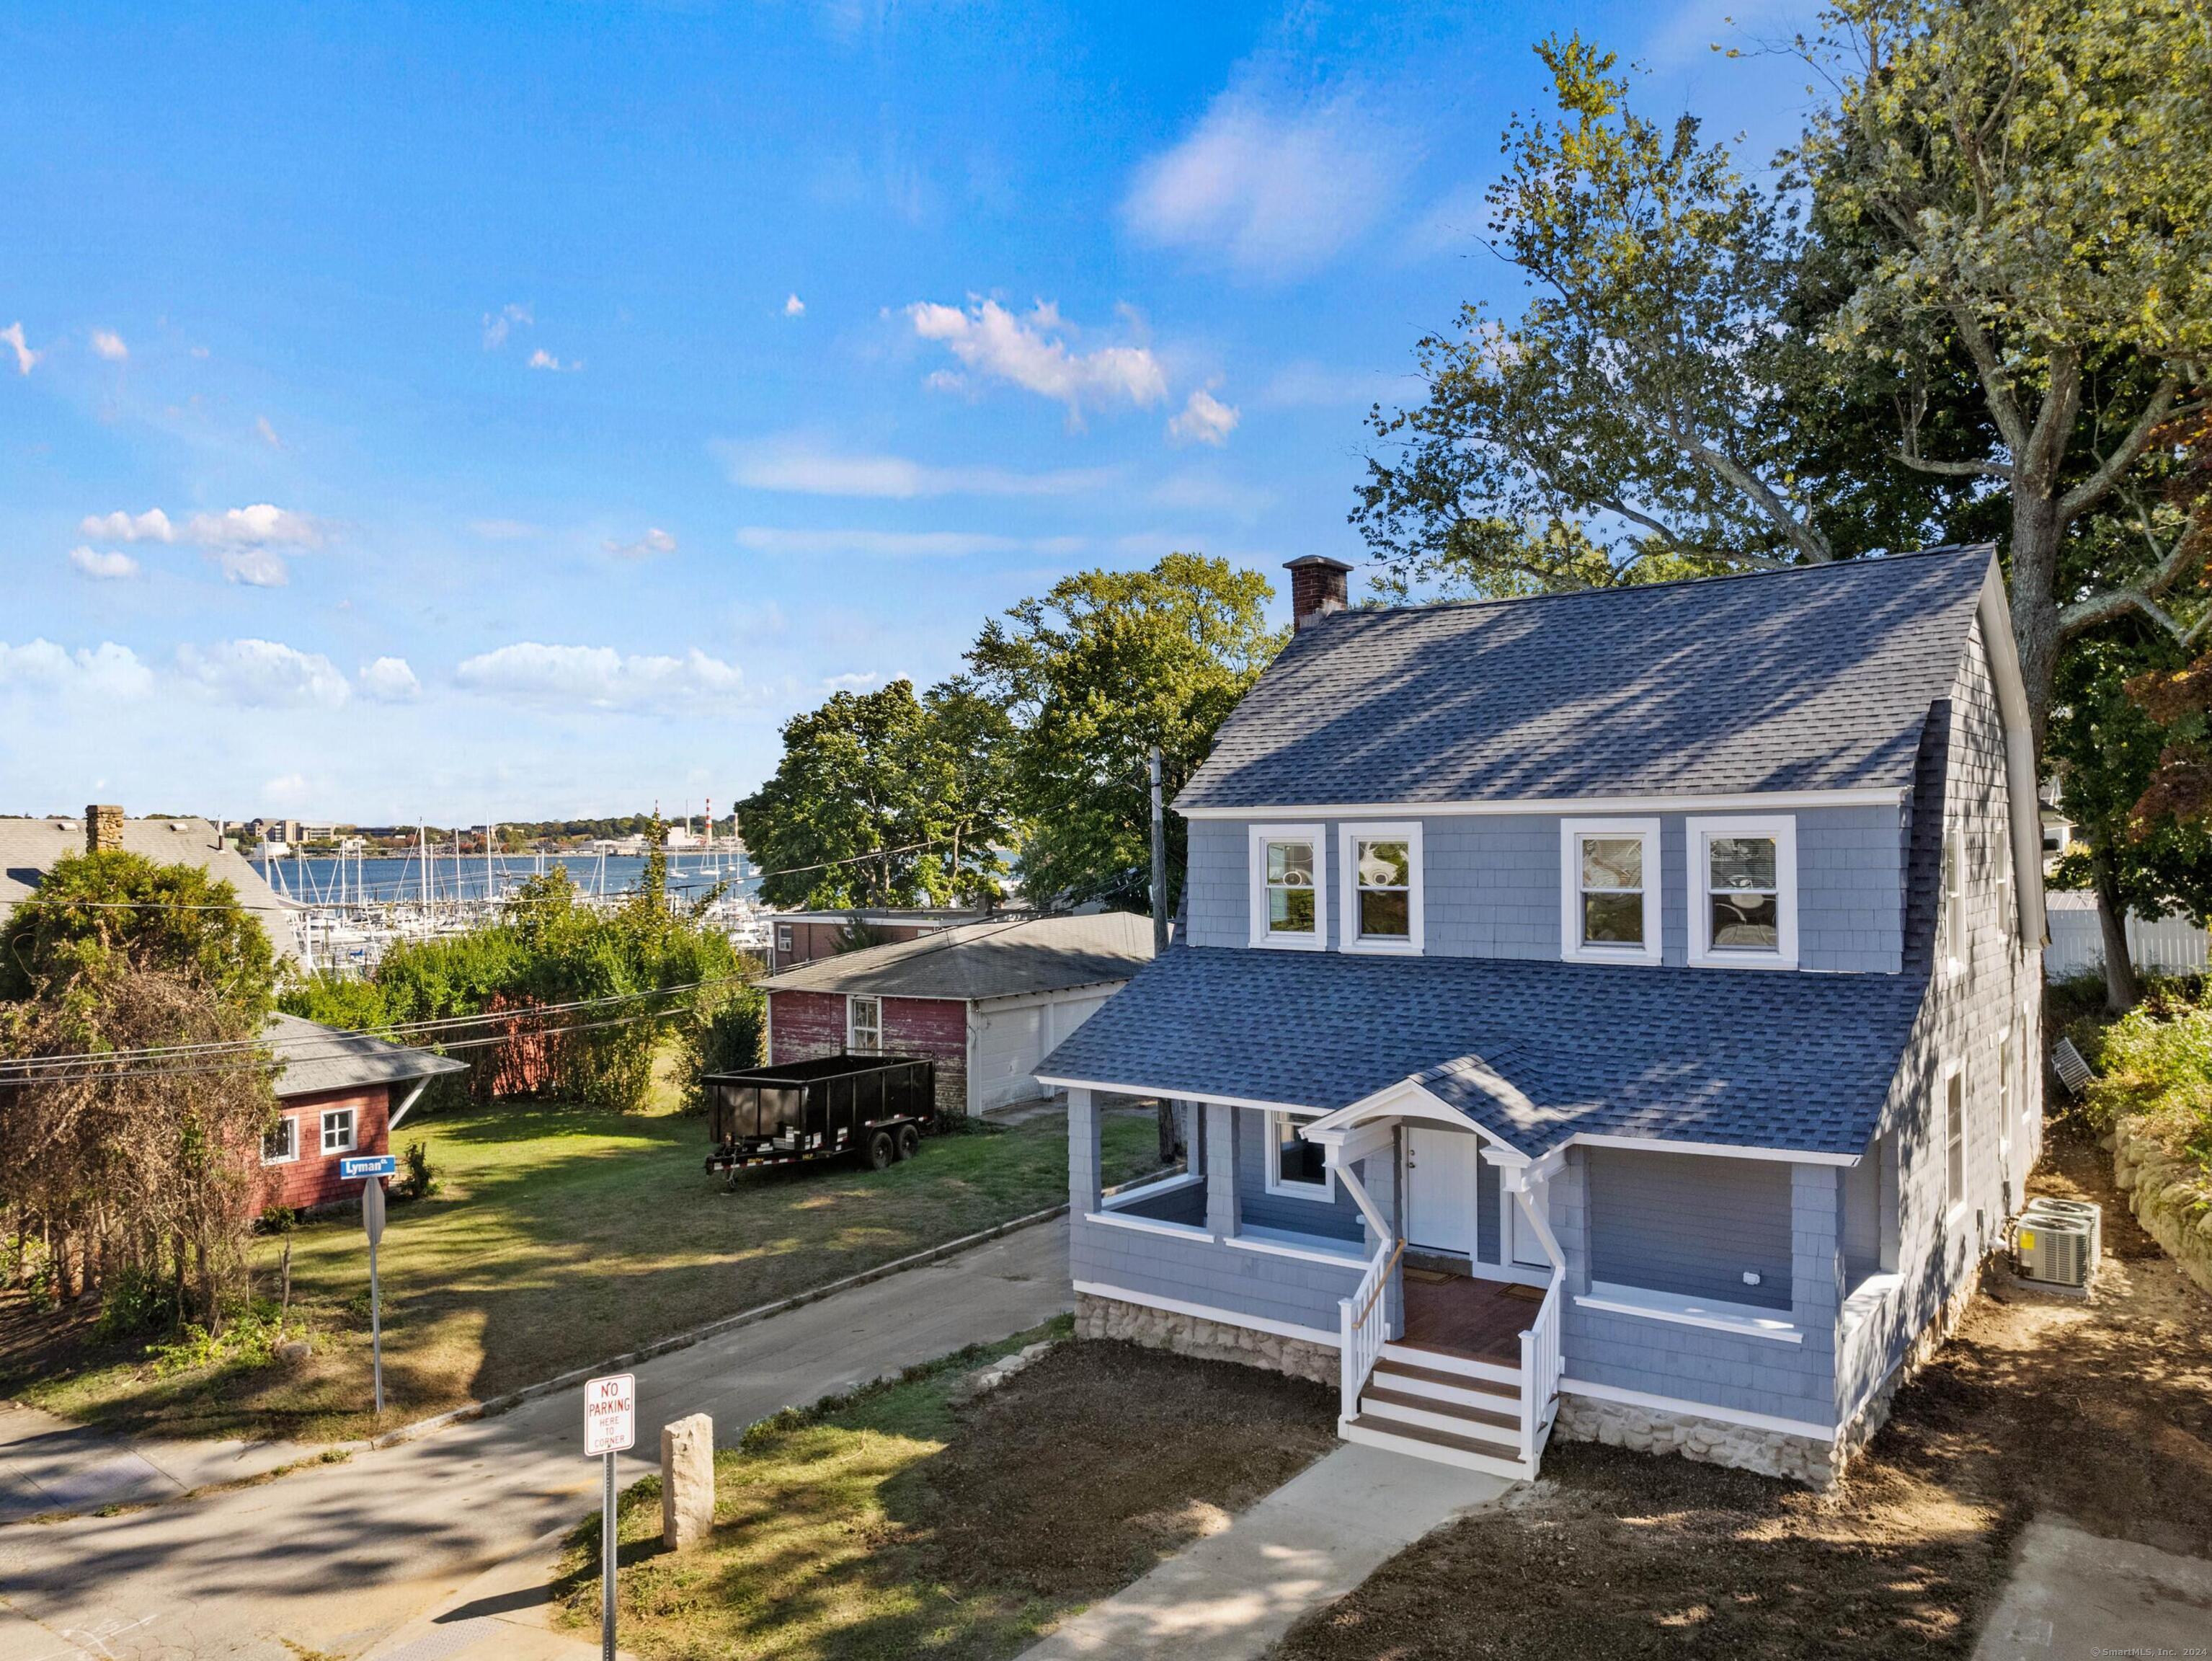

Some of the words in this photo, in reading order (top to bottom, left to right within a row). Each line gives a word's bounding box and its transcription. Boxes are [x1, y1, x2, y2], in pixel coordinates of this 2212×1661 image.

[346, 1161, 381, 1175] Lyman
[600, 1383, 618, 1397] NO
[589, 1397, 630, 1417] PARKING
[600, 1416, 619, 1427] HERE
[605, 1427, 614, 1435] TO
[595, 1435, 625, 1448] CORNER
